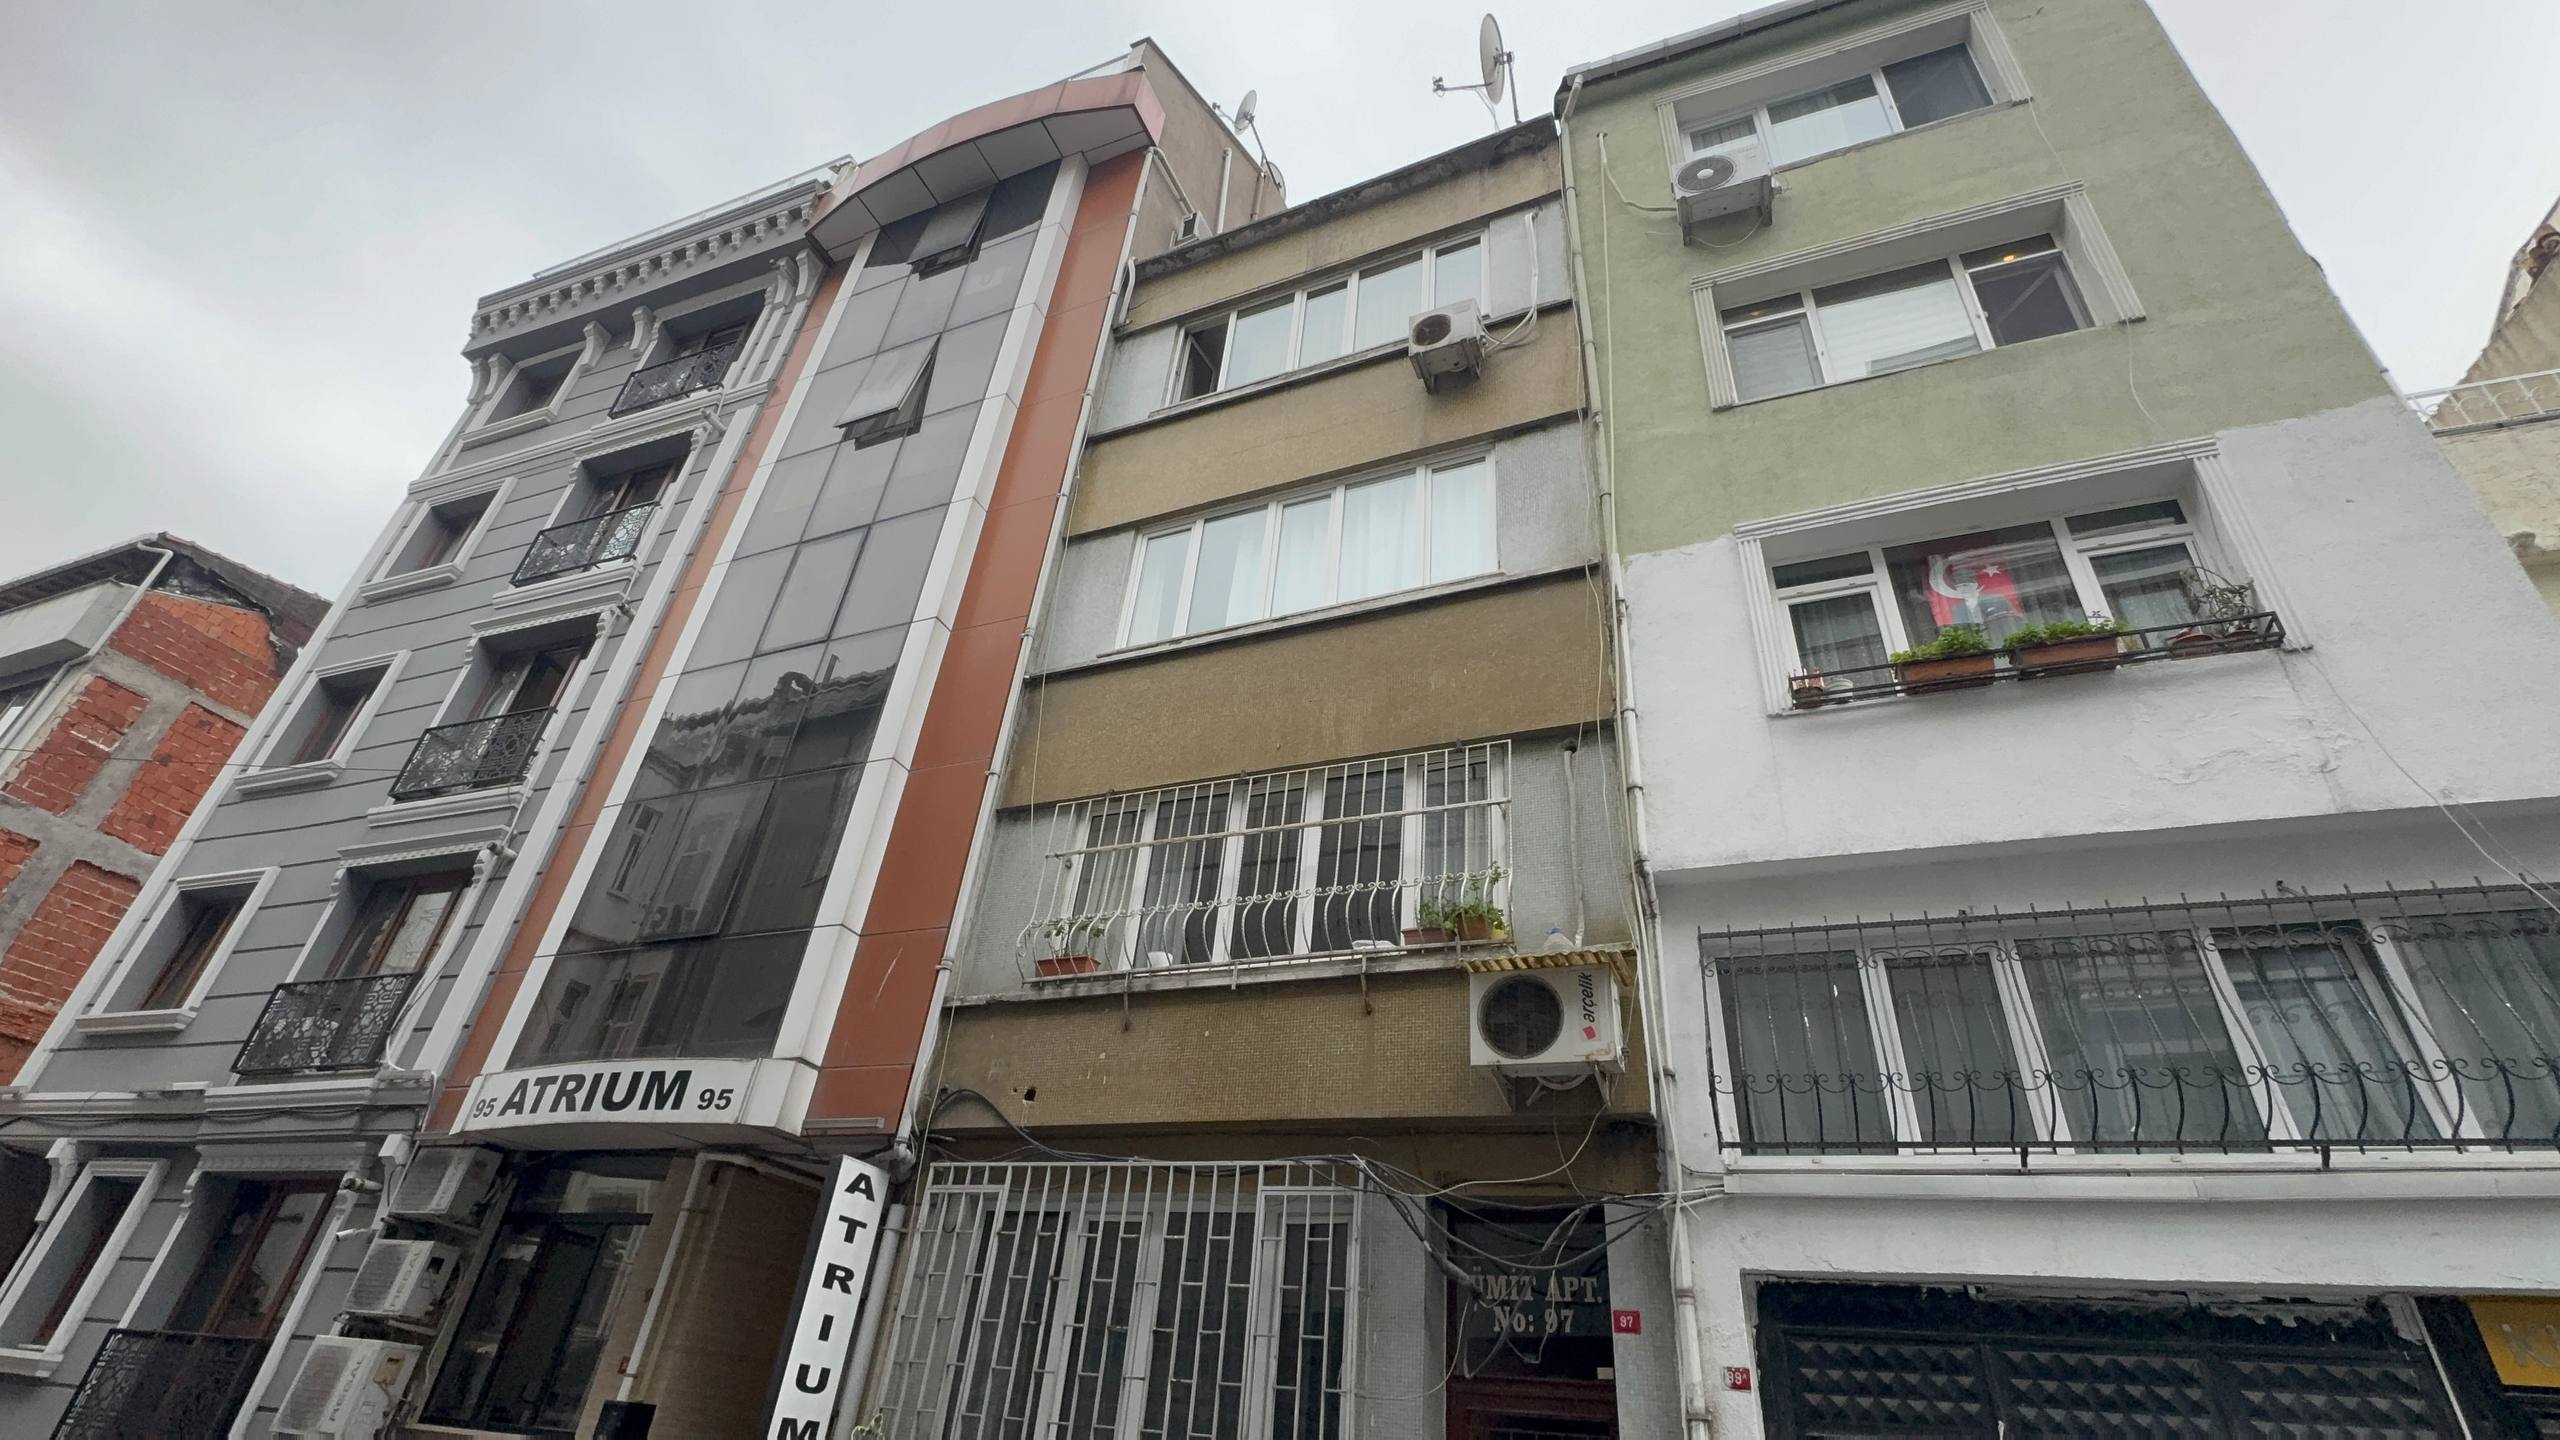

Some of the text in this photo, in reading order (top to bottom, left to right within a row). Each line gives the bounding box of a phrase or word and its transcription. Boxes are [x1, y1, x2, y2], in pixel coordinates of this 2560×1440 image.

[1577, 971, 1597, 1023] arçelik
[473, 1070, 734, 1118] 95 ATRIUM 95
[1544, 1275, 1602, 1303] APT.
[1493, 1306, 1574, 1333] No: 97
[1620, 1315, 1633, 1328] 97
